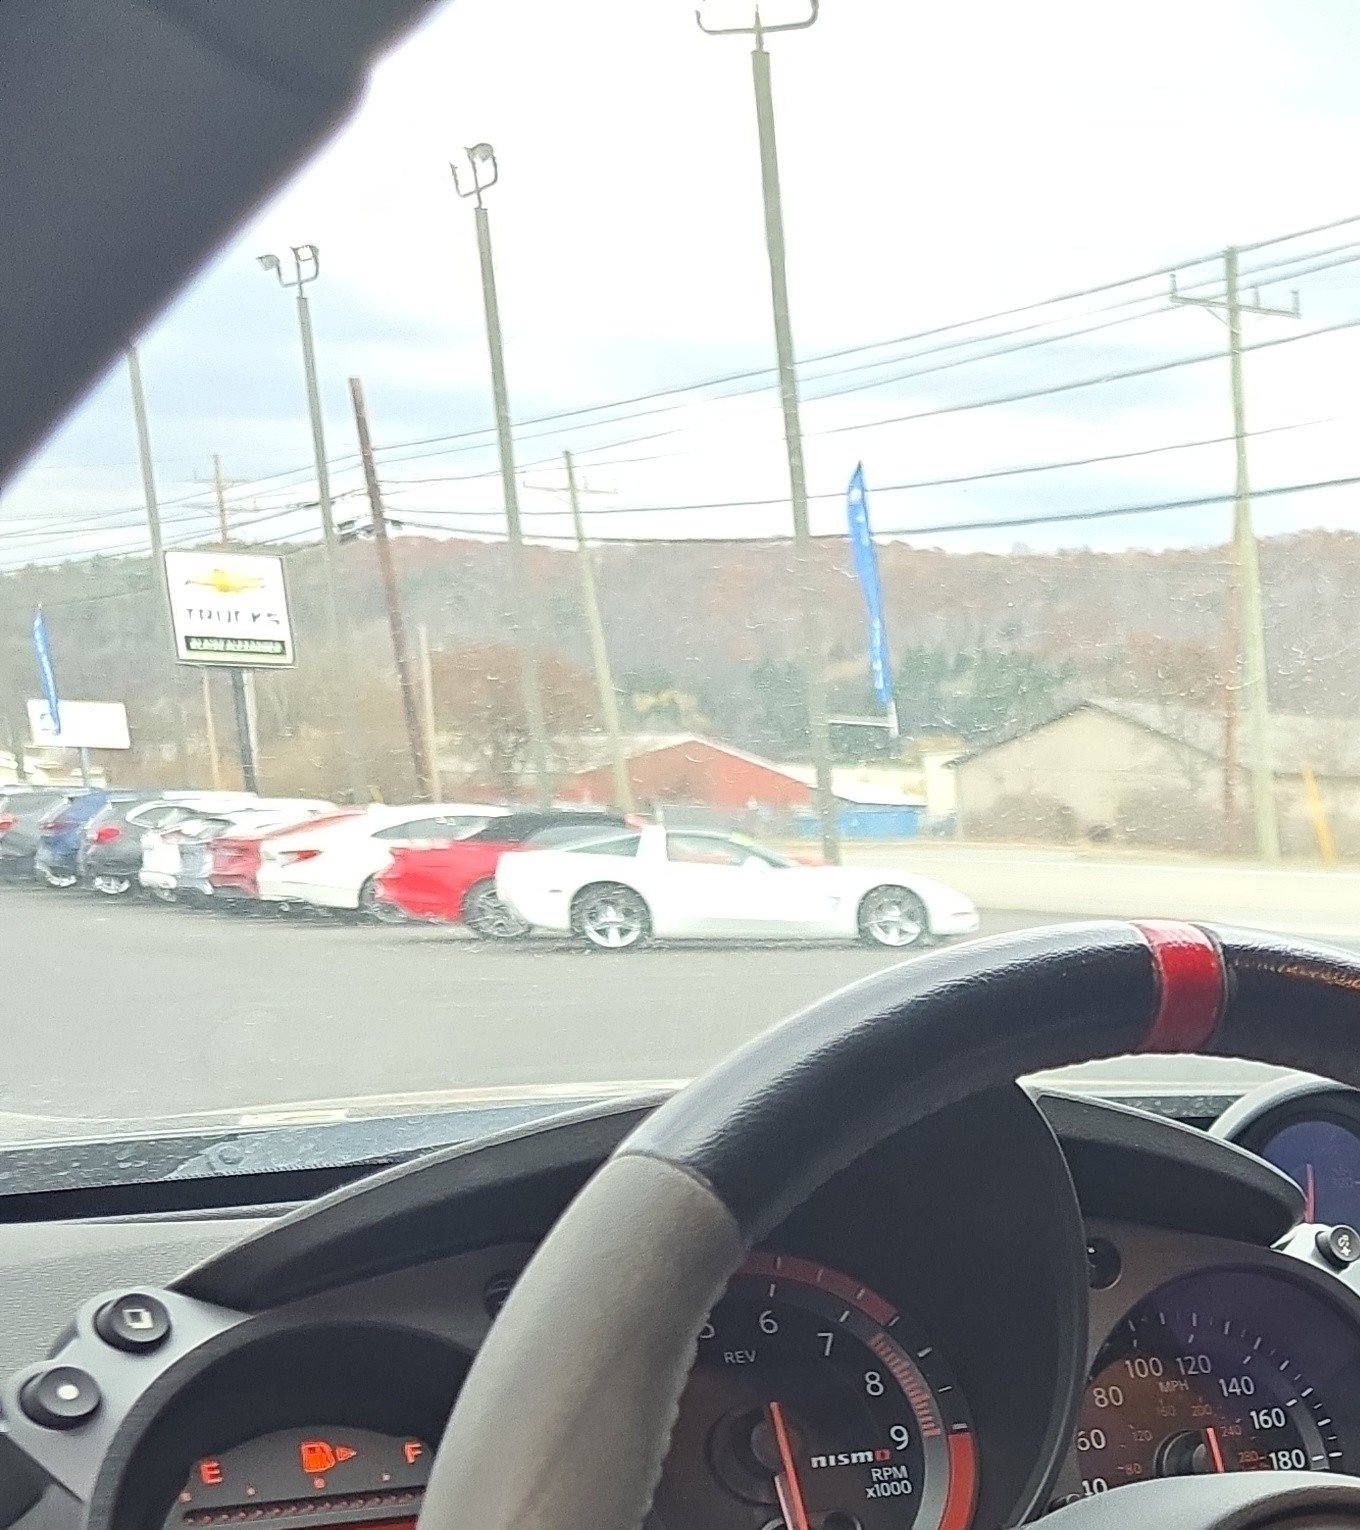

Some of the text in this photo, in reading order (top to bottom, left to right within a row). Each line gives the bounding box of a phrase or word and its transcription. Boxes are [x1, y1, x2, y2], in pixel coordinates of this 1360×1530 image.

[758, 1310, 779, 1334] 6
[817, 1332, 833, 1357] 7
[724, 1350, 757, 1364] REV
[1125, 1357, 1163, 1379] 100
[1176, 1354, 1212, 1375] 120
[864, 1371, 885, 1396] 8
[1158, 1381, 1190, 1393] MPH
[1219, 1375, 1255, 1397] 140
[1093, 1386, 1124, 1409] 80
[1250, 1407, 1286, 1430] 160
[889, 1425, 911, 1450] 9
[1077, 1428, 1107, 1451] 60
[405, 1442, 422, 1464] F
[811, 1449, 892, 1469] nismo
[1269, 1449, 1305, 1470] 180
[200, 1460, 223, 1484] E
[871, 1466, 908, 1482] RPM
[866, 1480, 913, 1499] x1000
